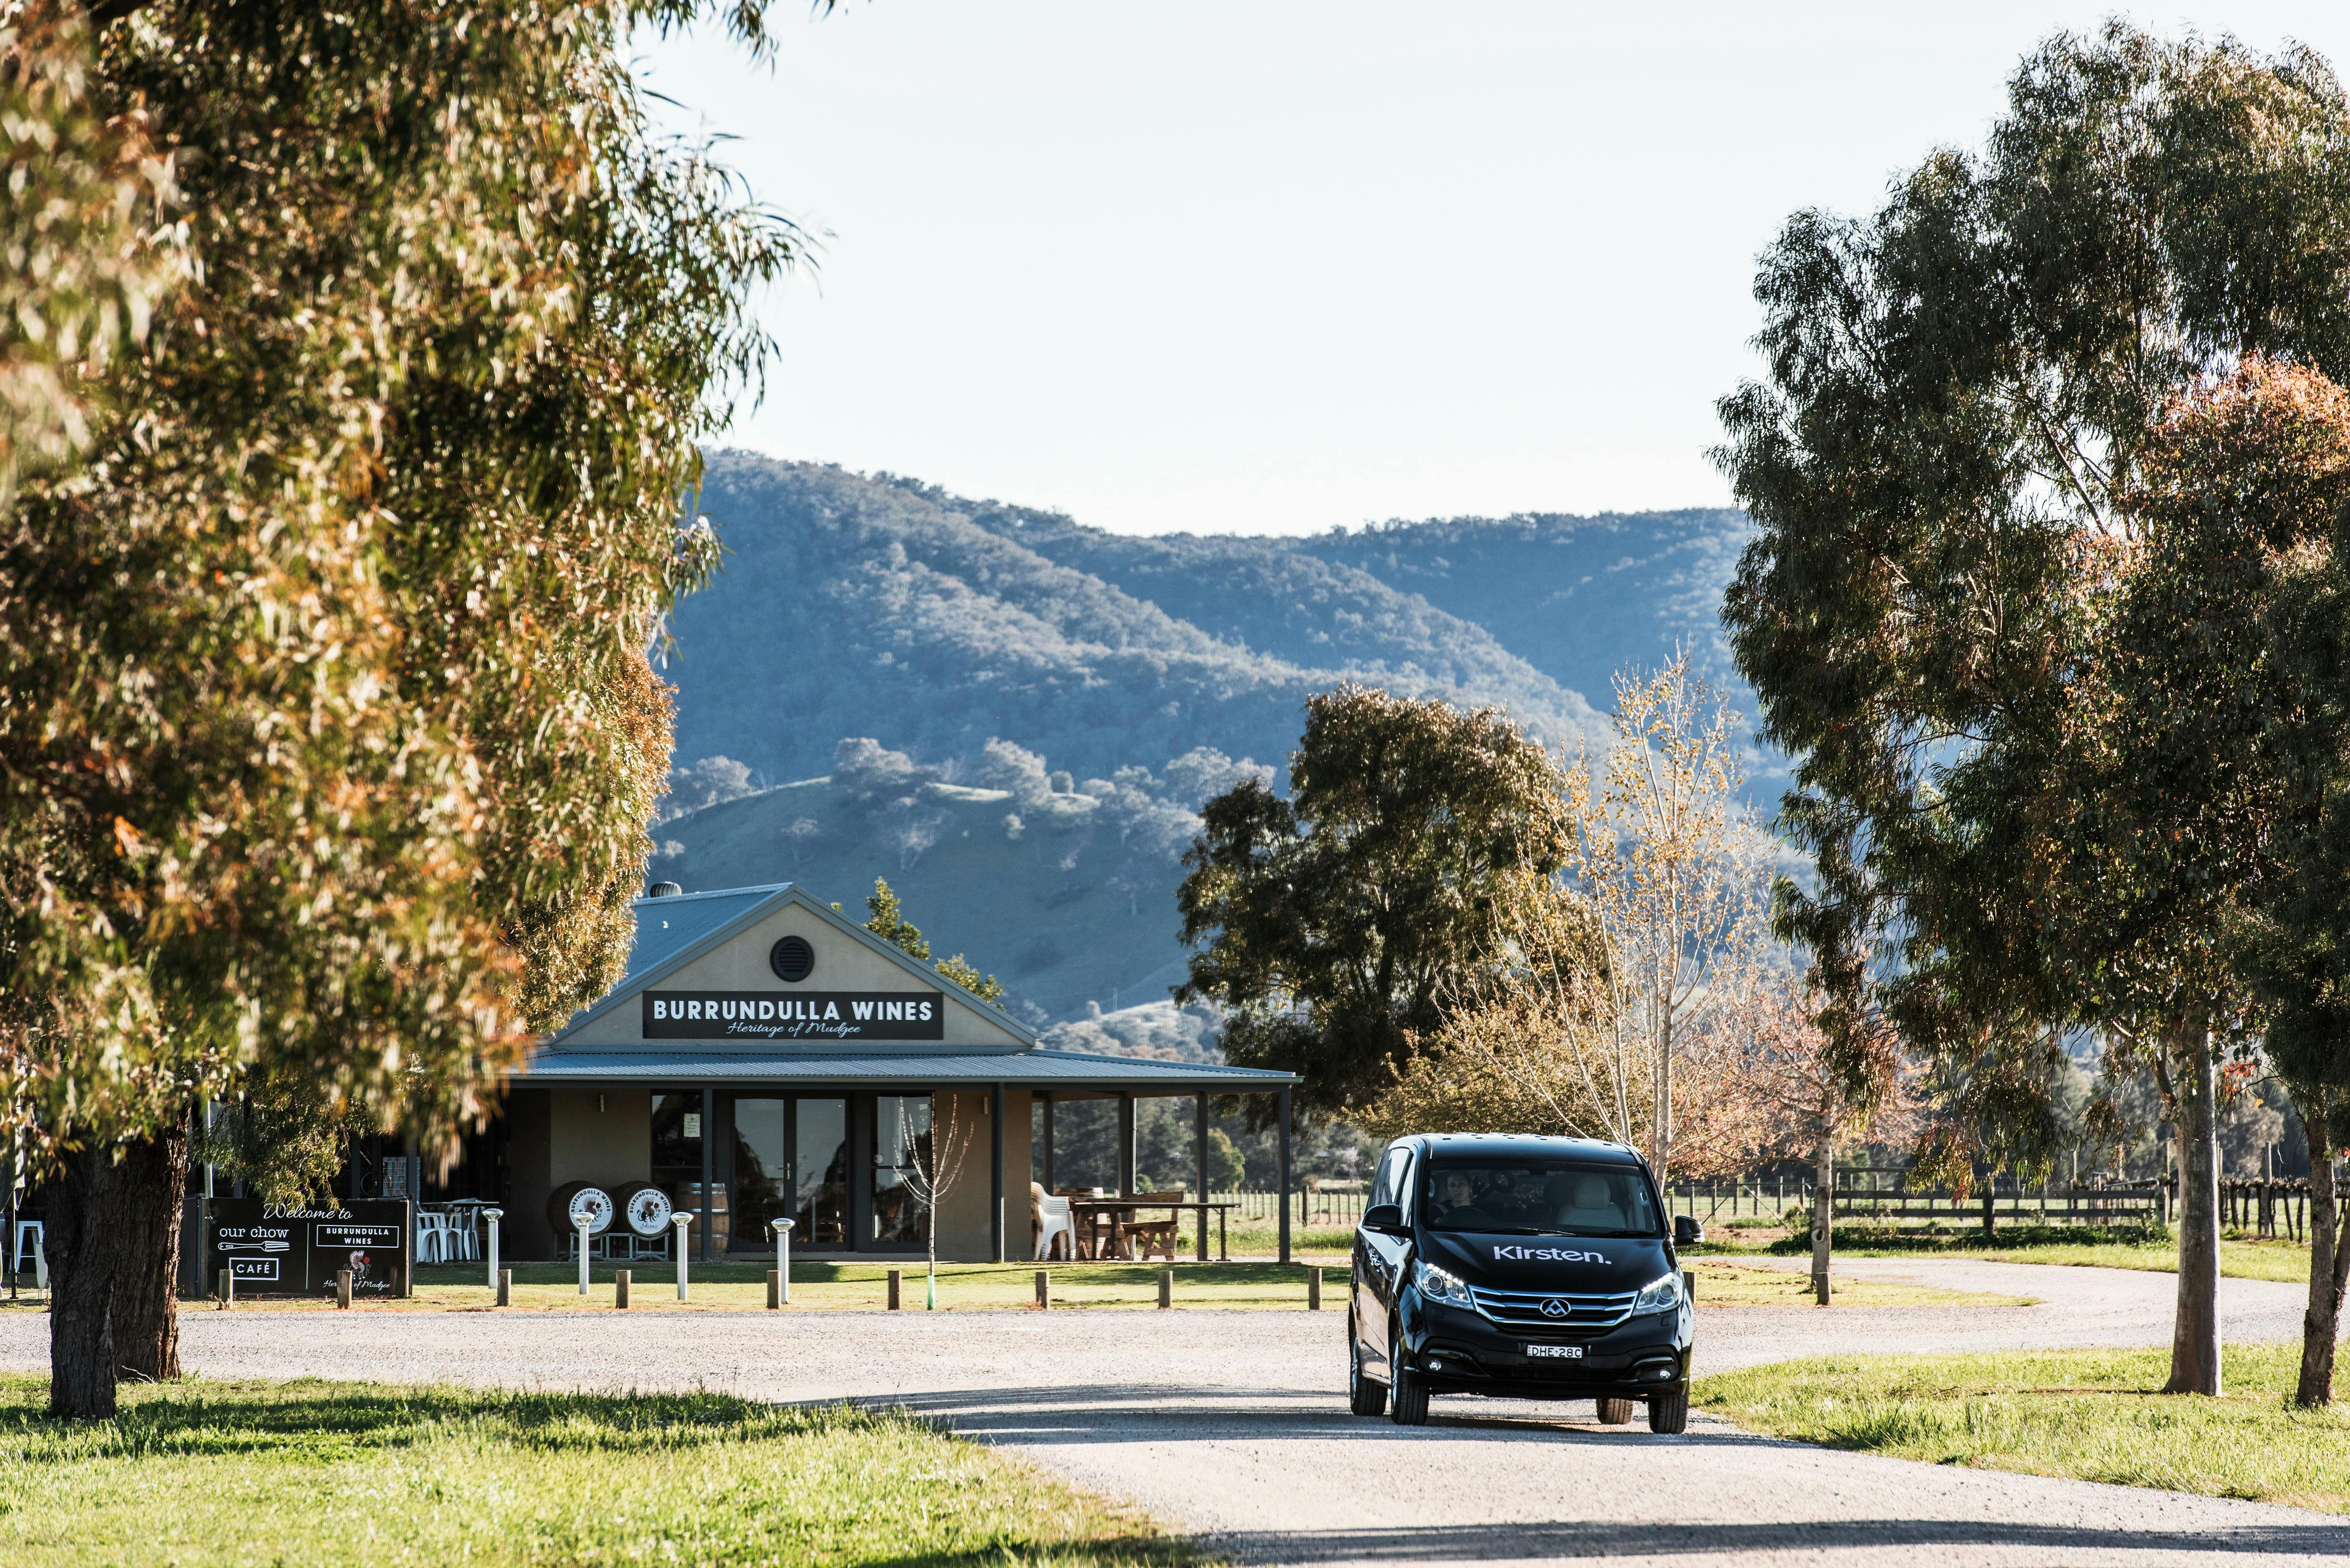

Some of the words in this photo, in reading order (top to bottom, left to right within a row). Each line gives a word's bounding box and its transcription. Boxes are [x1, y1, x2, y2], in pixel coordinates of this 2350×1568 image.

[654, 1001, 840, 1019] BURRUNDULLA
[852, 1002, 932, 1020] WINES
[726, 1022, 784, 1037] Heritage
[788, 1022, 805, 1038] of
[806, 1023, 861, 1038] Mudgee
[571, 1190, 600, 1212] BURRUNDULLA
[602, 1195, 611, 1212] WINES
[629, 1191, 658, 1213] BURRUNDULLA
[659, 1196, 669, 1213] WINES
[263, 1202, 336, 1219] Welcome
[338, 1207, 353, 1219] to
[219, 1228, 246, 1237] our
[250, 1226, 289, 1238] chow
[1494, 1246, 1612, 1264] Kirsten.
[237, 1262, 270, 1274] CAFÉ
[353, 1280, 363, 1290] of
[361, 1280, 391, 1291] Mudgee
